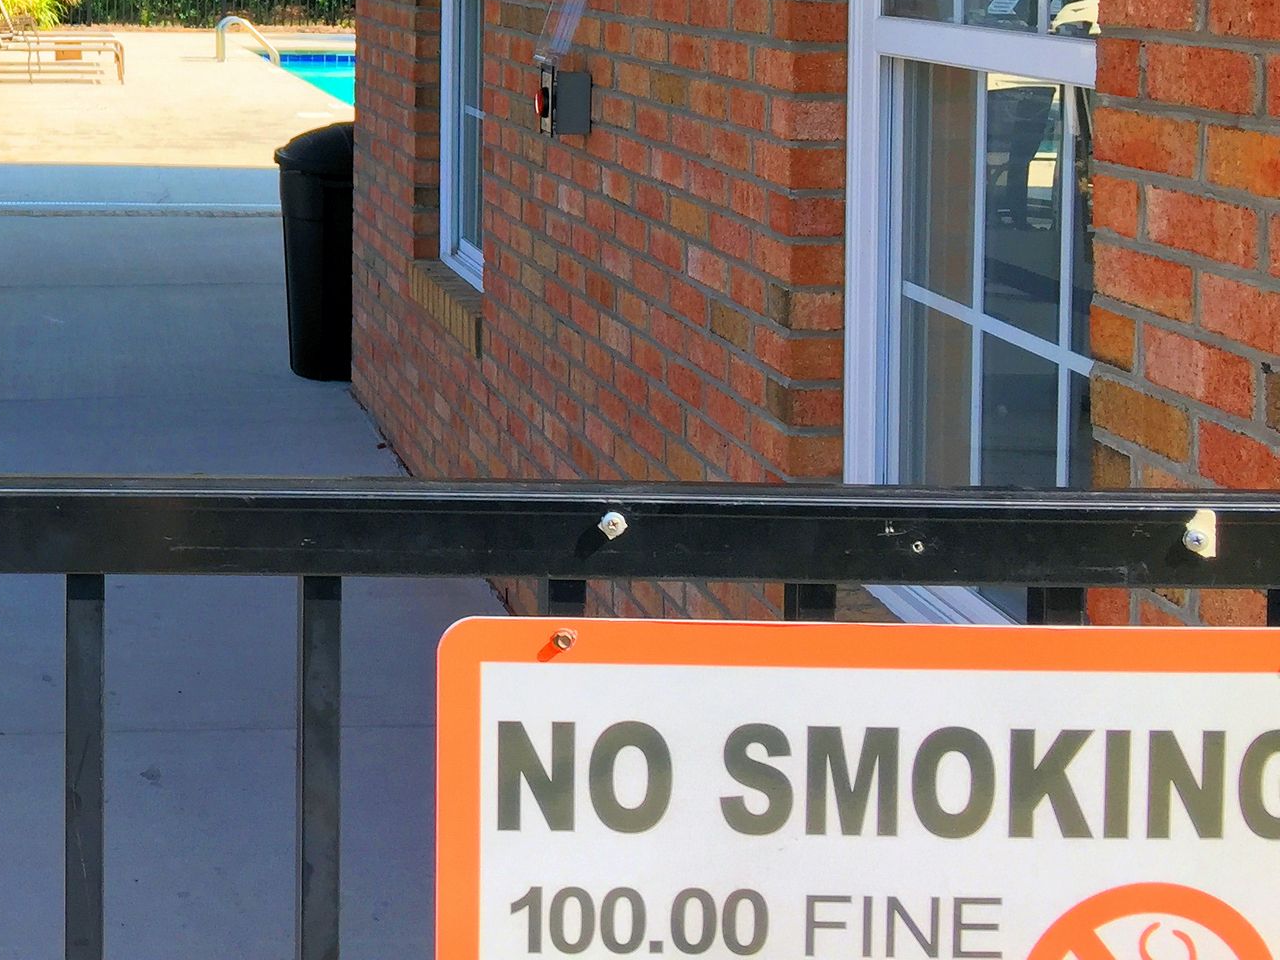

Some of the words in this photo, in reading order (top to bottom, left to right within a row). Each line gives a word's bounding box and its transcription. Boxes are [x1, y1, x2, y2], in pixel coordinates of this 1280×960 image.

[497, 721, 673, 834] NO
[510, 887, 769, 956] 100.00
[804, 895, 1003, 959] FINE
